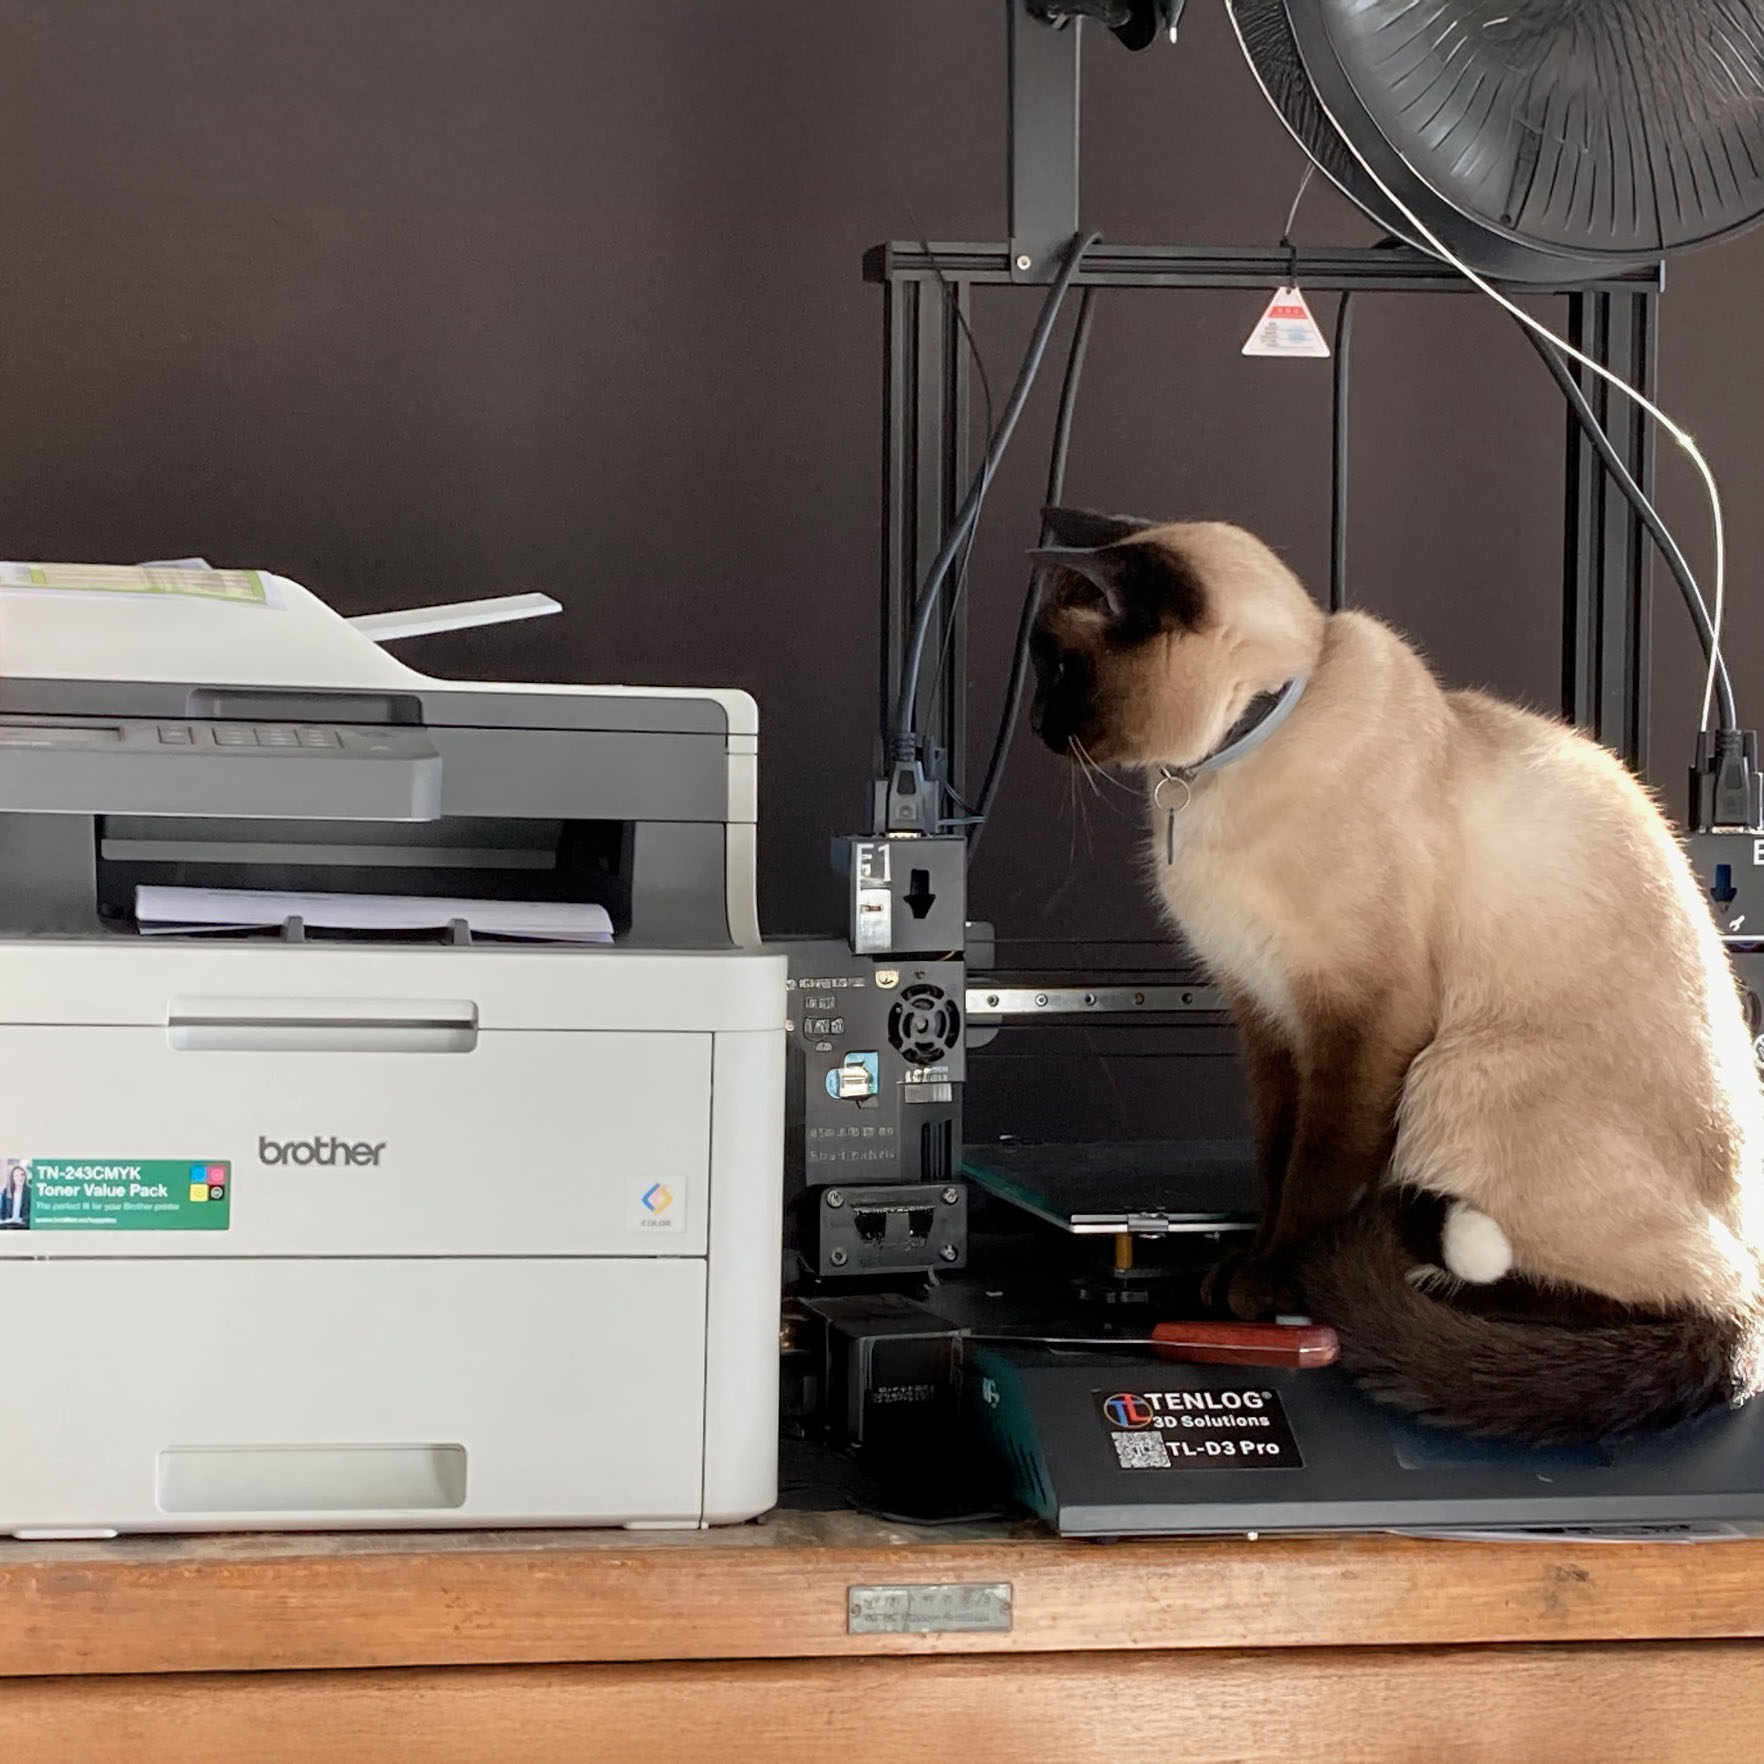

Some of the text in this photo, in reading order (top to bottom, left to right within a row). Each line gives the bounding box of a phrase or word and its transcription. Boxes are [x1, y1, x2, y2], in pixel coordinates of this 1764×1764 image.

[258, 1136, 387, 1166] brother
[36, 1166, 142, 1180] TN-243CMYK
[36, 1183, 169, 1197] Toner Value Pack
[1153, 1414, 1271, 1429] 3D Solutions
[1166, 1440, 1281, 1456] TL-D3 Pro
